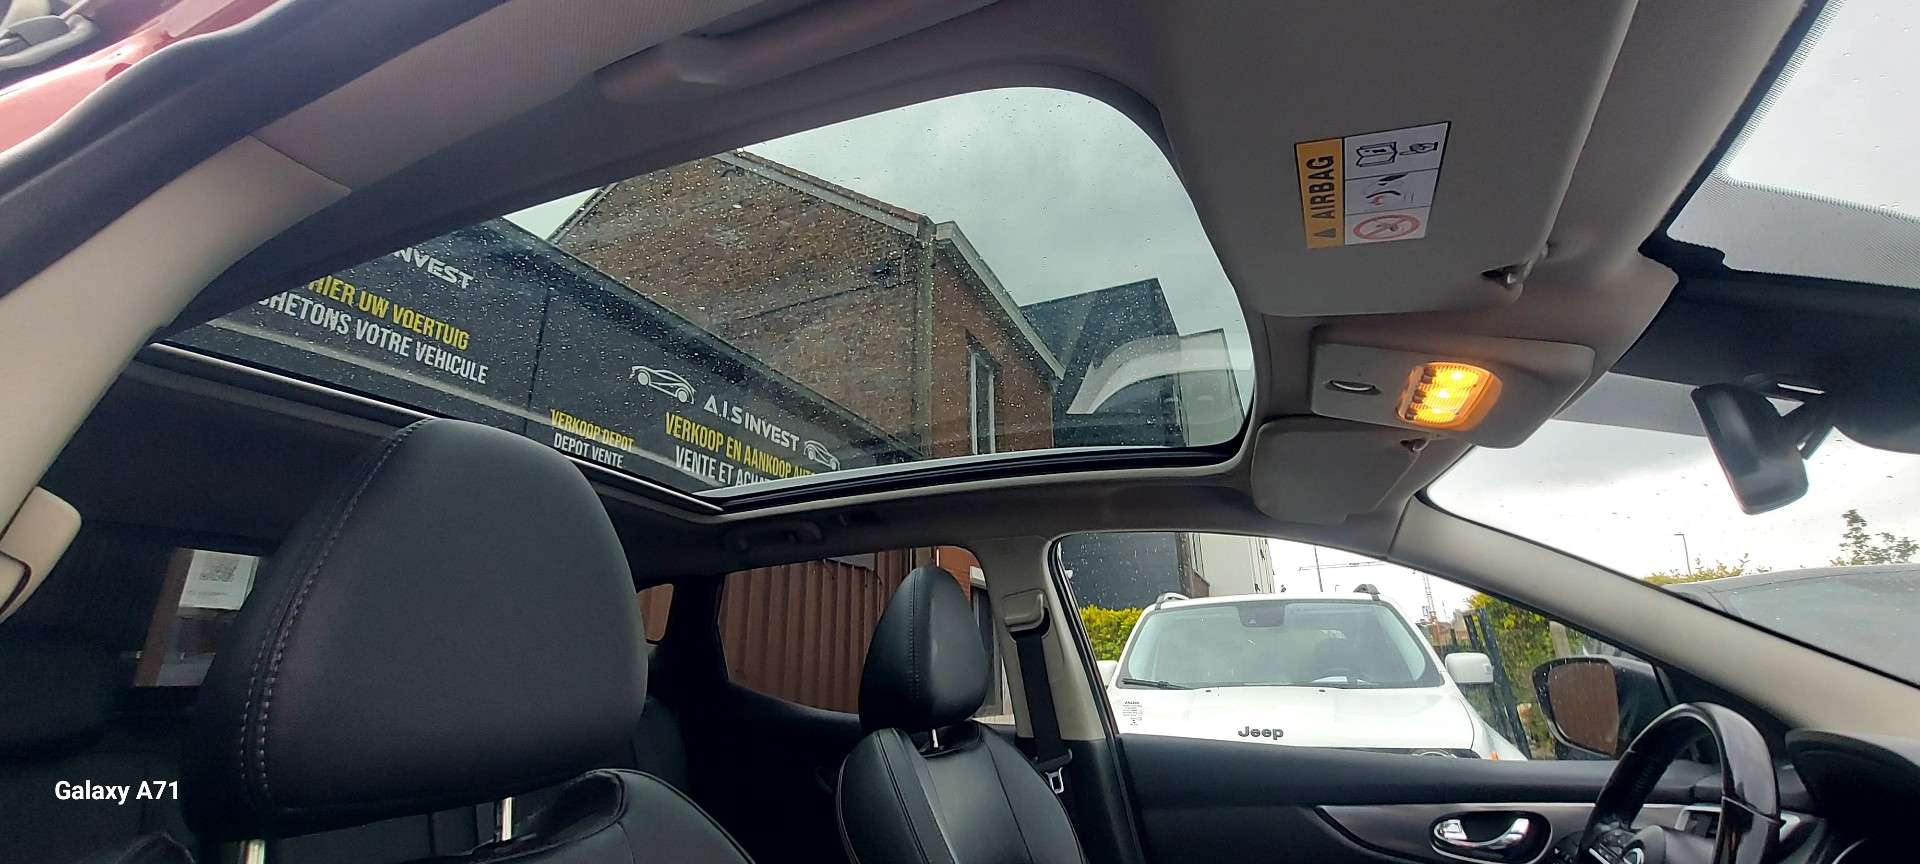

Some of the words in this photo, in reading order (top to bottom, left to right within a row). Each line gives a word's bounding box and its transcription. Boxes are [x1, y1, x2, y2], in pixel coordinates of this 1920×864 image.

[1306, 155, 1336, 219] AIRBAG
[393, 246, 474, 289] NVEST
[358, 290, 389, 319] UW
[392, 303, 470, 350] VOERTUIG
[355, 318, 413, 357] VOTRE
[415, 341, 489, 385] VEHICULE
[550, 408, 600, 441] VERKOOP
[601, 428, 635, 452] DEPOT
[553, 432, 591, 457] DEPOT
[592, 445, 624, 469] VENTE
[665, 411, 724, 453] VERKOOP
[725, 435, 742, 461] EN
[743, 445, 792, 478] AANKOOP
[744, 411, 800, 452] INVEST
[675, 445, 717, 479] VENTE
[718, 461, 735, 485] ET
[1237, 725, 1284, 741] Jeep
